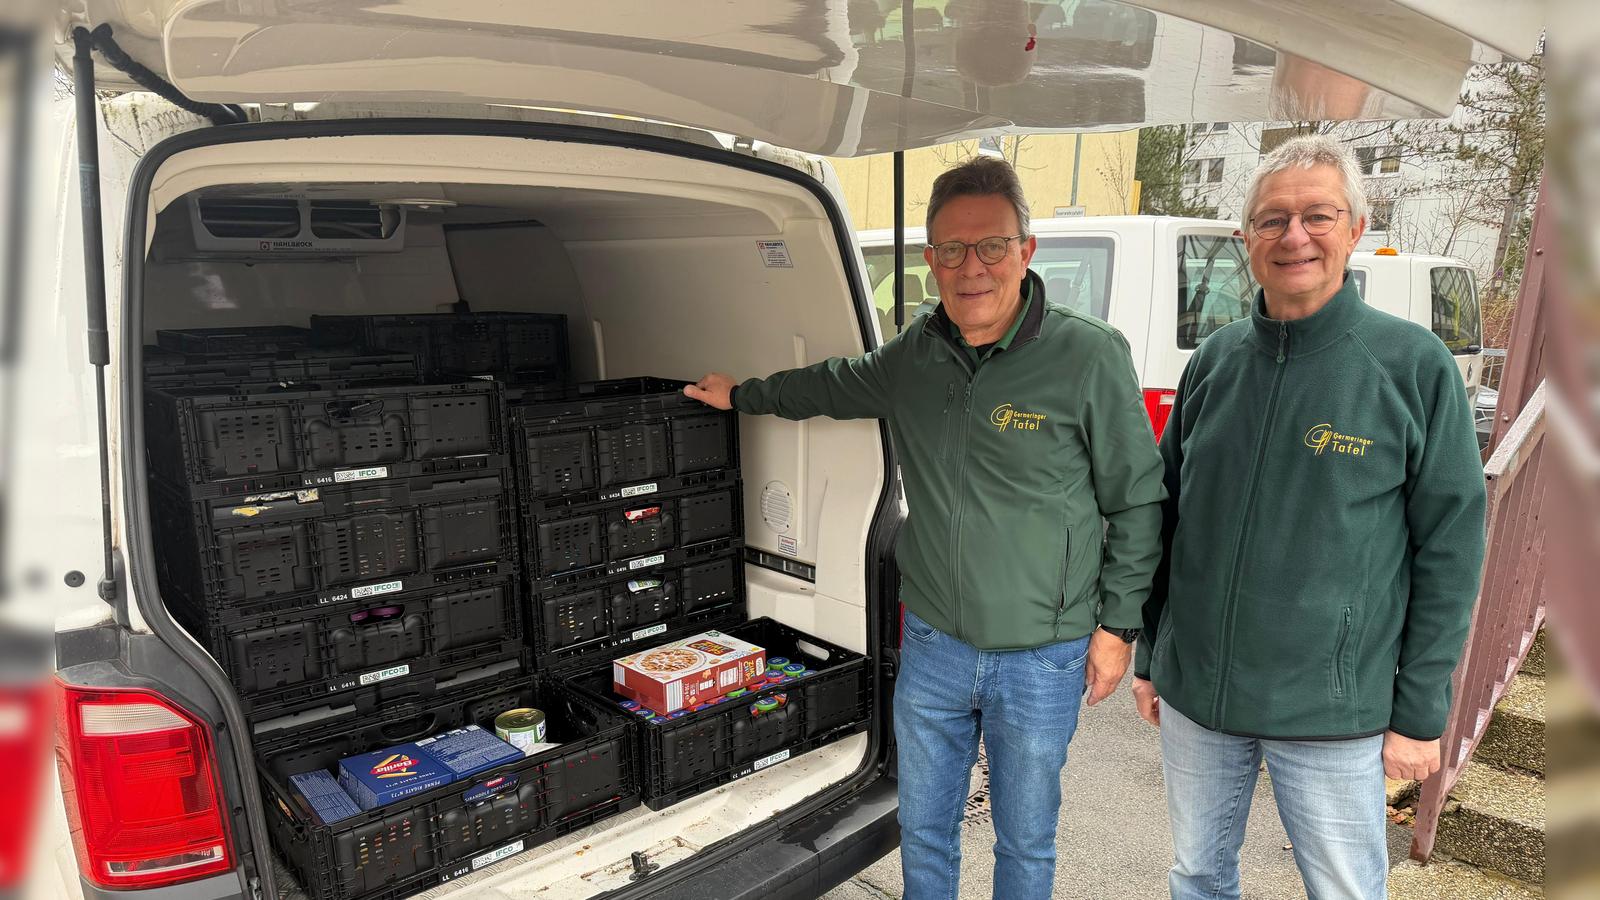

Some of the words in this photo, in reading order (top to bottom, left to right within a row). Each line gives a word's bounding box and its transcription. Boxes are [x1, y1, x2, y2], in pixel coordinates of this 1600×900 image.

[1013, 411, 1047, 420] Germeringer
[1013, 419, 1040, 431] Tafel
[1333, 432, 1374, 446] Germeringer
[1332, 441, 1366, 456] Tafel
[358, 469, 377, 477] IFCO
[374, 584, 392, 592] IFCO
[381, 668, 399, 677] IFCO
[375, 759, 412, 773] Barilla
[424, 780, 441, 789] PENNE
[405, 785, 423, 794] RIGATE
[495, 846, 514, 857] IFCO
[454, 867, 469, 877] 6416
